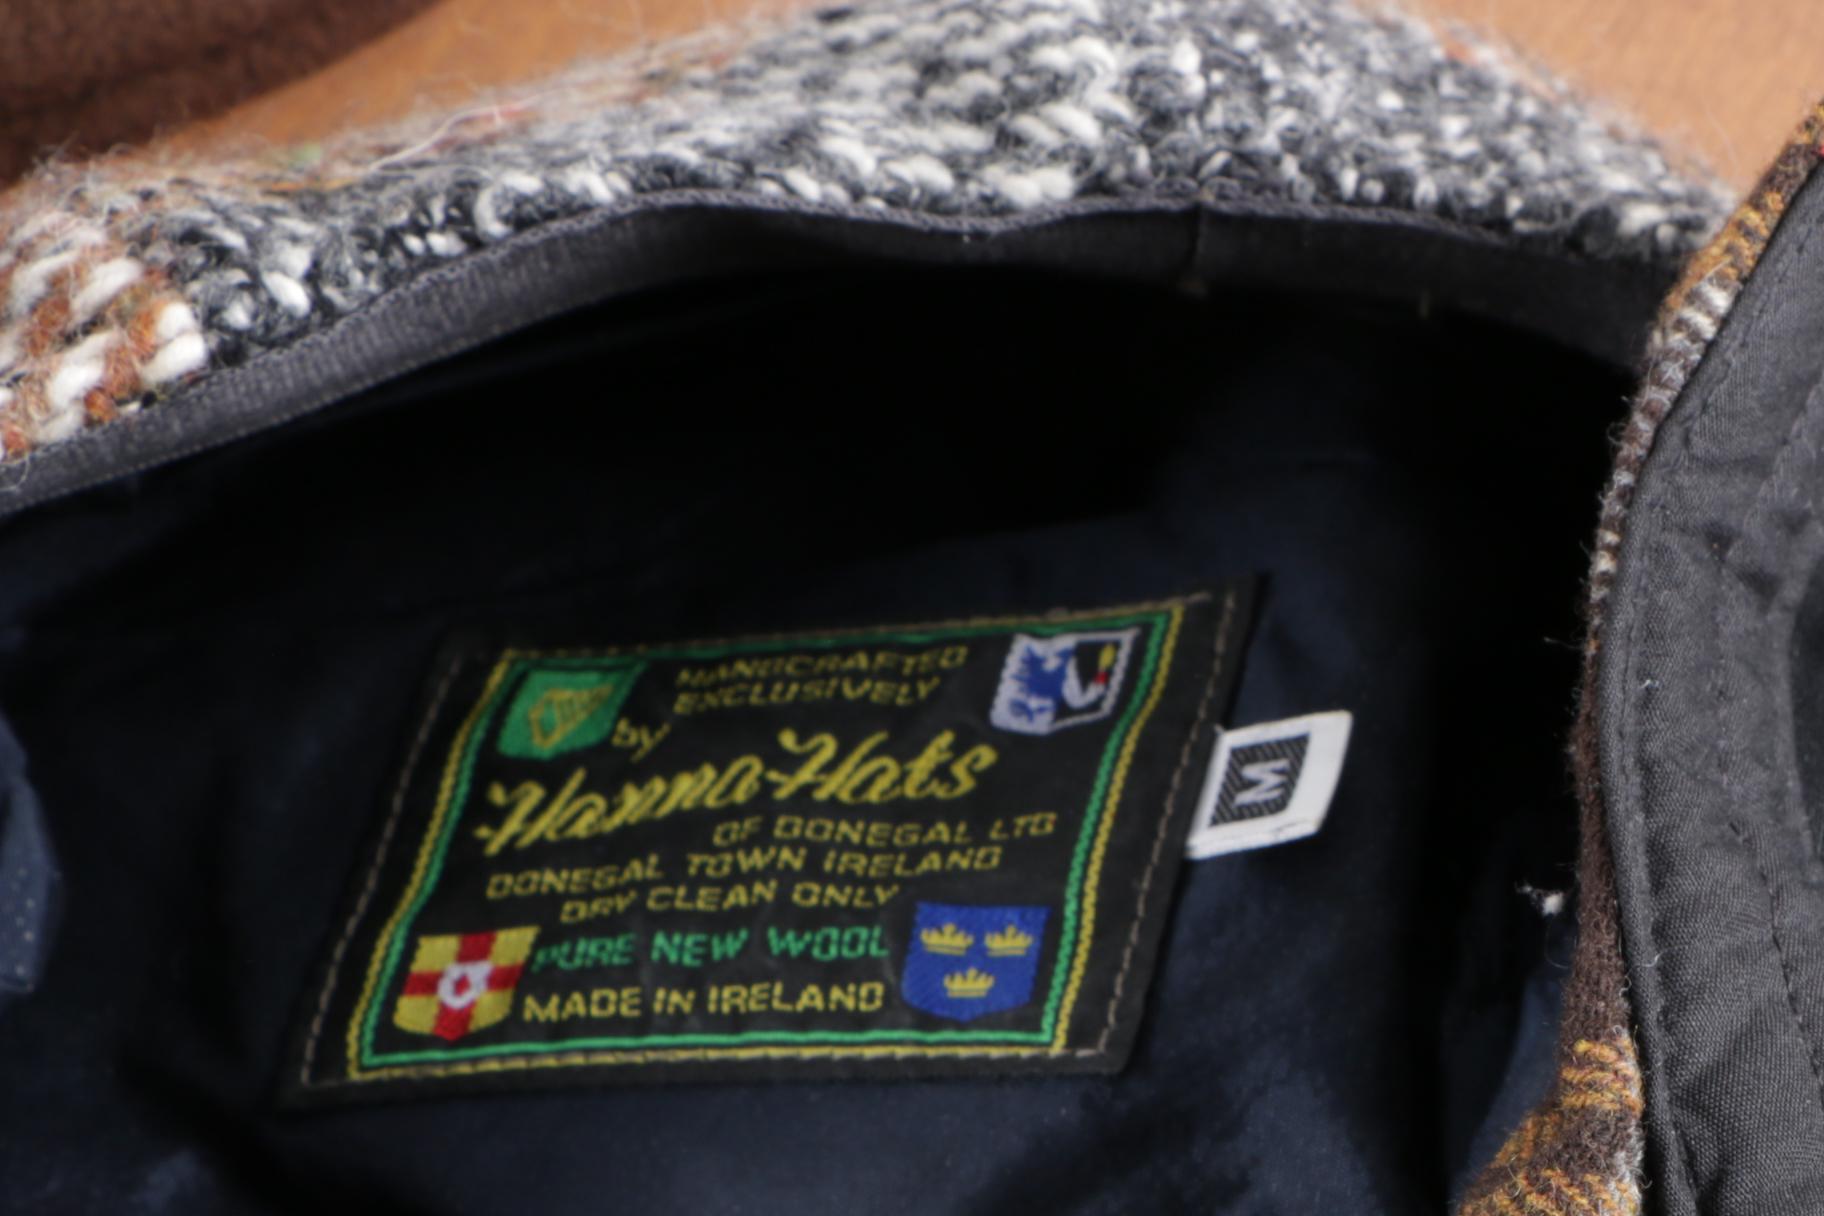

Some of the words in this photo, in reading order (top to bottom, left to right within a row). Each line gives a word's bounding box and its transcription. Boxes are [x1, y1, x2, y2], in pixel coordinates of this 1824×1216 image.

[673, 674, 941, 715] EXCLUSIVELY
[712, 814, 763, 848] OF
[772, 813, 974, 848] DONEGAL
[989, 811, 1058, 842] LTD
[485, 852, 665, 901] DONEGAL
[685, 845, 808, 879] TOWN
[822, 845, 1002, 879] IRELAND
[559, 890, 638, 925] DRY
[645, 878, 779, 912] CLEAN
[791, 881, 901, 909] ONLY
[530, 931, 638, 974] PURE
[650, 926, 749, 968] NEW
[766, 923, 890, 962] WOOL
[521, 985, 643, 1023] MADE
[652, 986, 697, 1015] IN
[707, 980, 885, 1016] IRELAND
